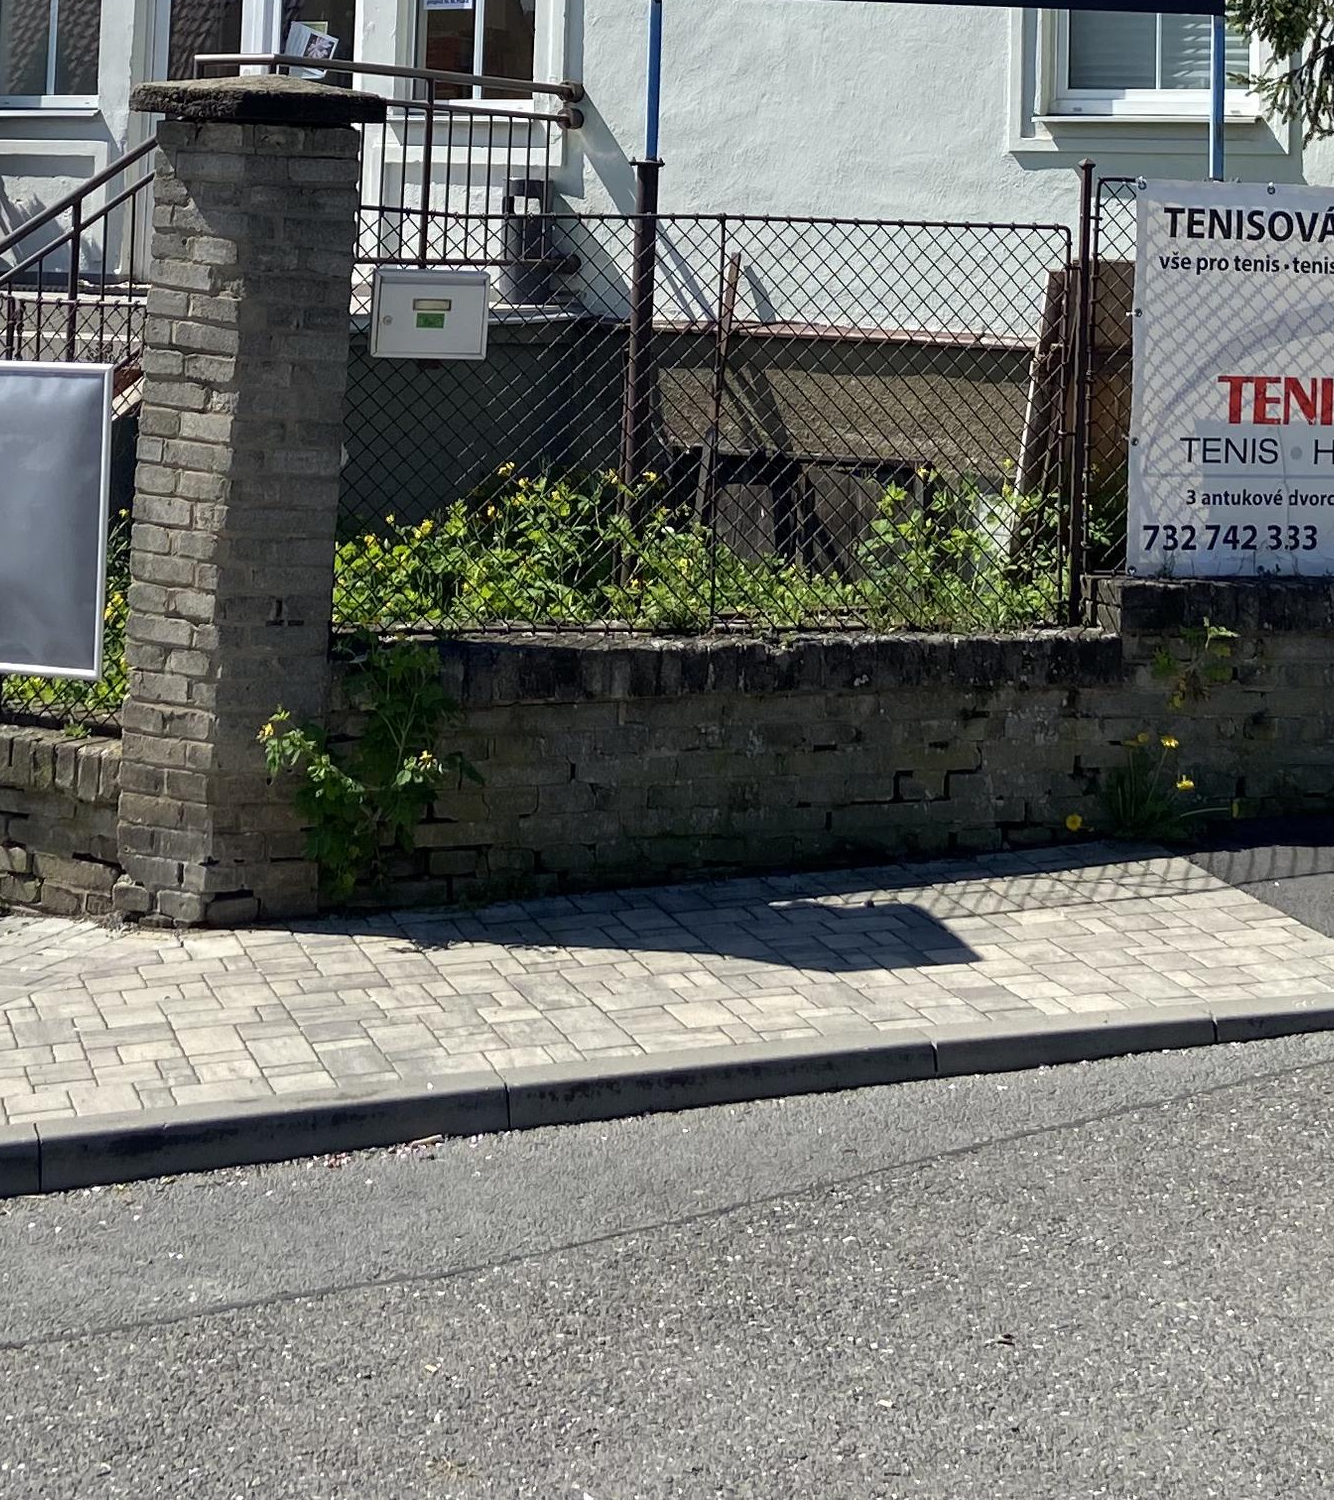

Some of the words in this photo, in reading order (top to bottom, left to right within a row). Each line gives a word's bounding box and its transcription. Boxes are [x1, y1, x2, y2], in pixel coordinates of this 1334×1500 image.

[1158, 252, 1192, 270] vše
[1196, 256, 1229, 275] pro
[1234, 254, 1280, 272] tenis
[1180, 436, 1279, 465] TENIS
[1186, 489, 1196, 505] 3
[1201, 488, 1283, 506] antukové
[1143, 524, 1197, 551] 732
[1205, 524, 1258, 551] 742
[1267, 524, 1318, 551] 333
